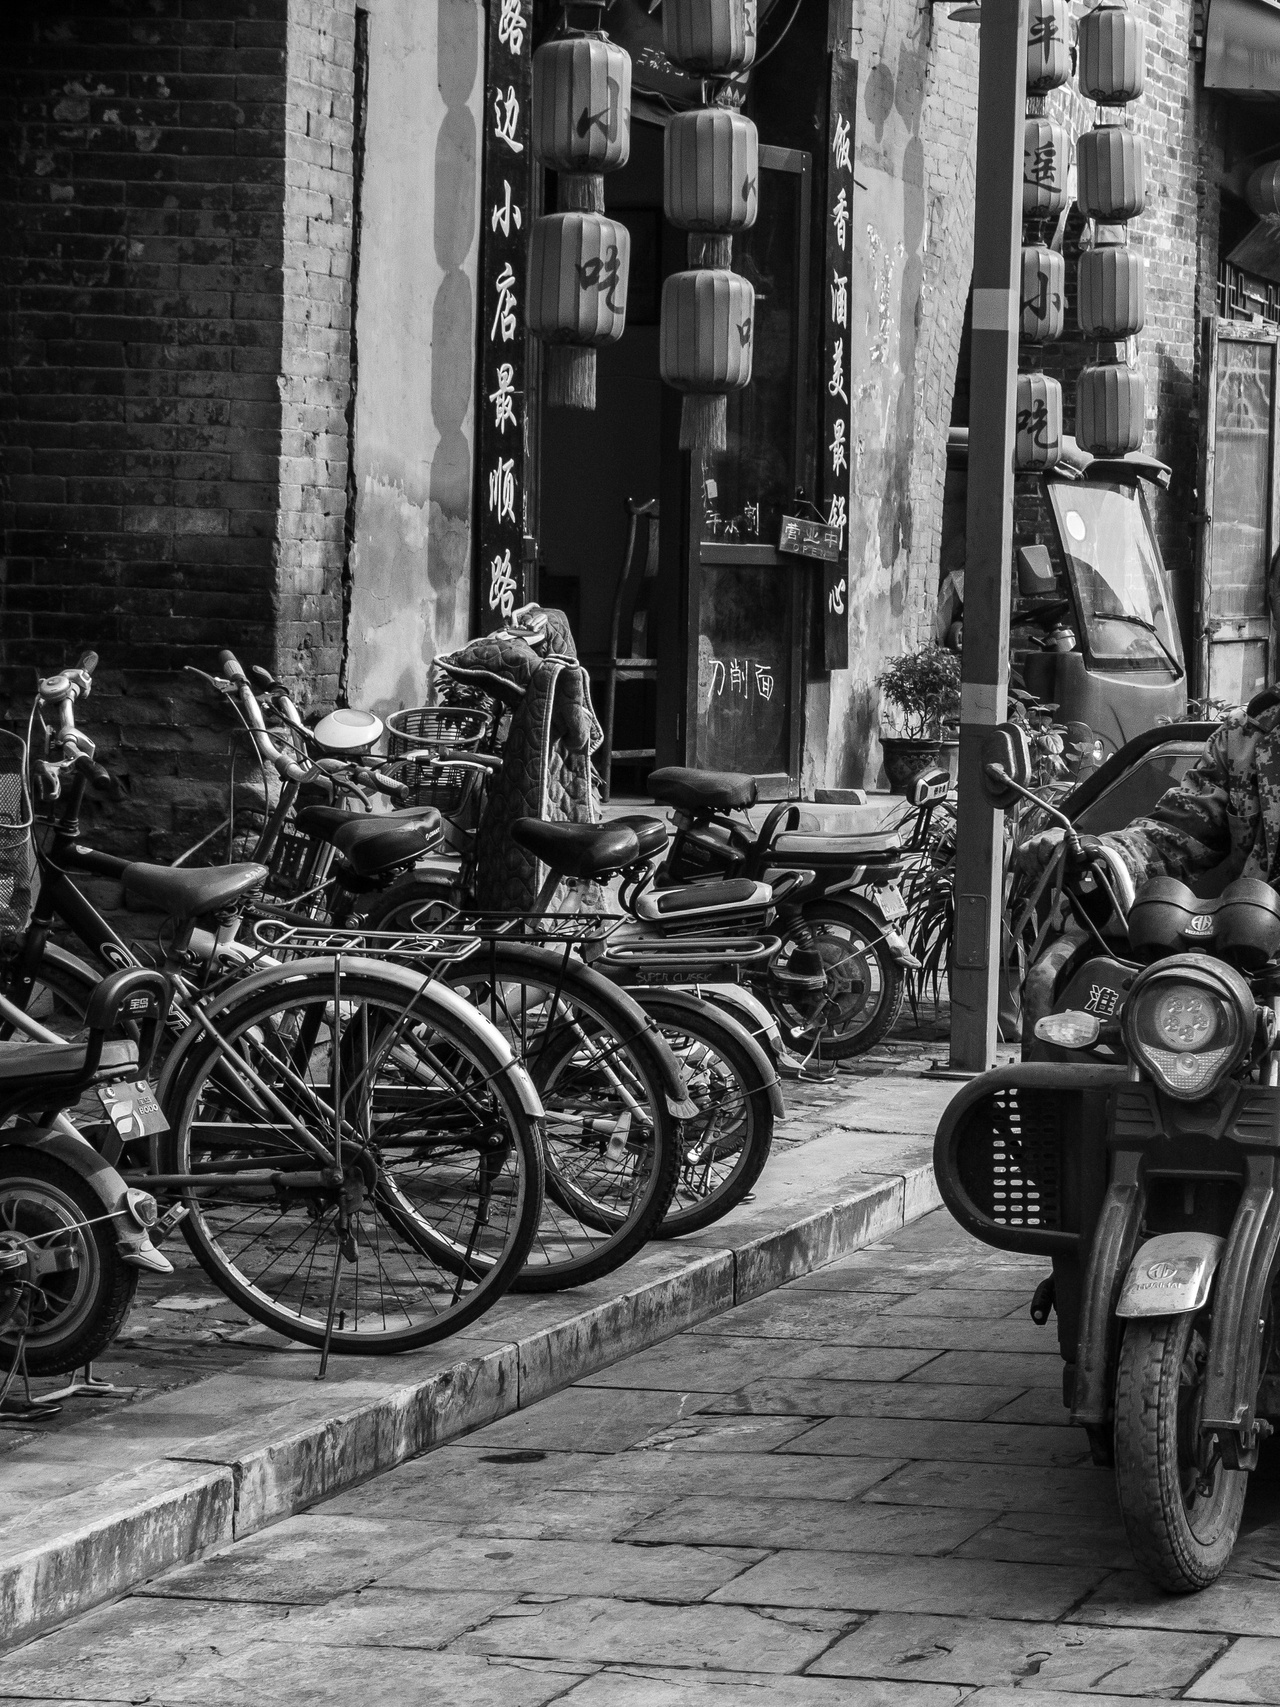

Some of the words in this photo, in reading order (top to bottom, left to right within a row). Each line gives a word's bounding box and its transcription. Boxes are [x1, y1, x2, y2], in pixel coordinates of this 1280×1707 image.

[784, 522, 839, 548] 营业中
[792, 543, 827, 559] OPEN
[708, 658, 774, 701] 刀削面
